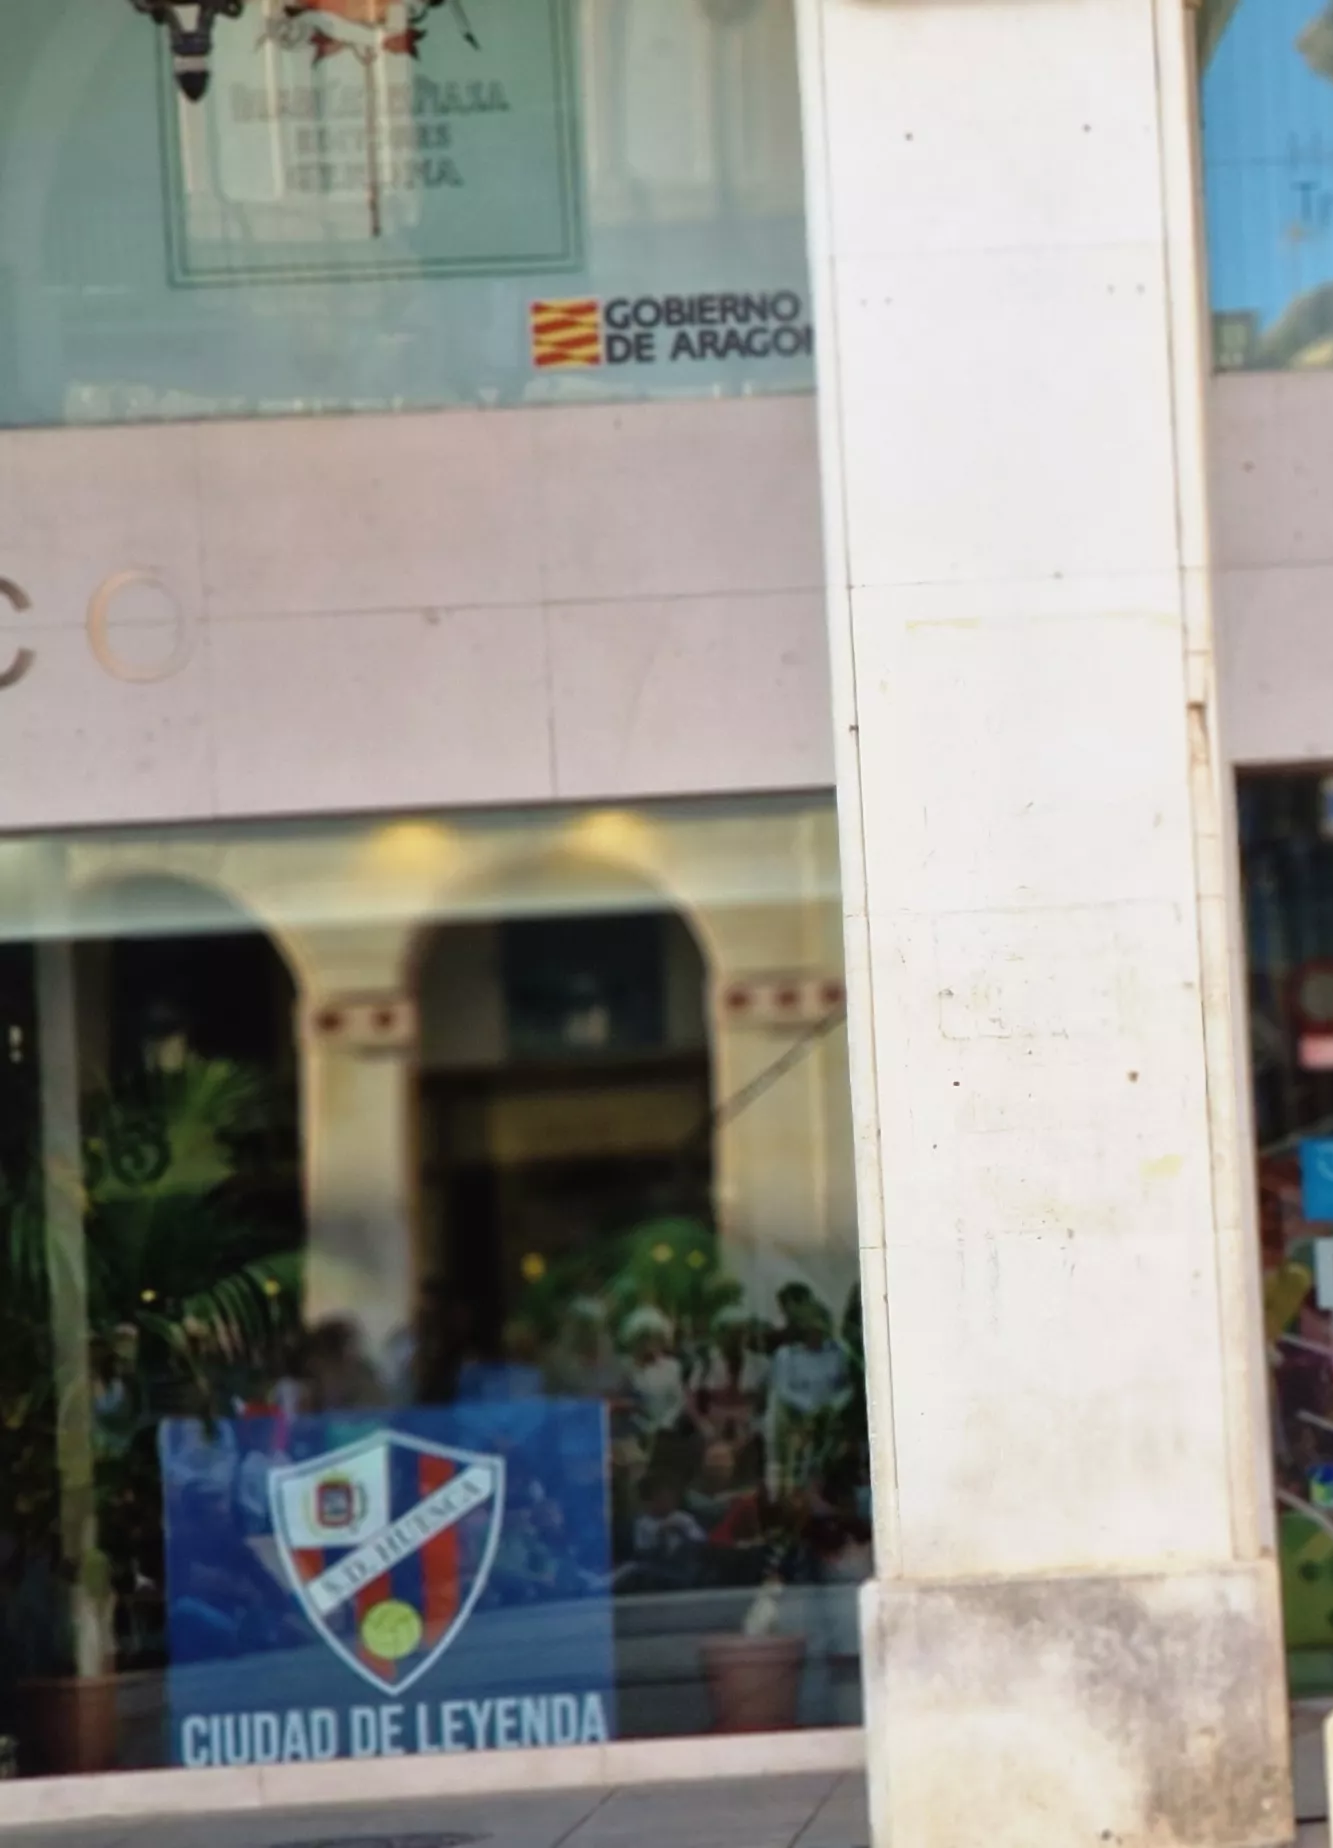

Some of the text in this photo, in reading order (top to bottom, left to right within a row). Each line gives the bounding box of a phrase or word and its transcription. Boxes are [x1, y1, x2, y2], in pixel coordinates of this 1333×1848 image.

[603, 290, 803, 331] GOBIERNO
[604, 331, 657, 365] DE
[180, 1693, 610, 1769] CIUDAD DE LEYENDA
